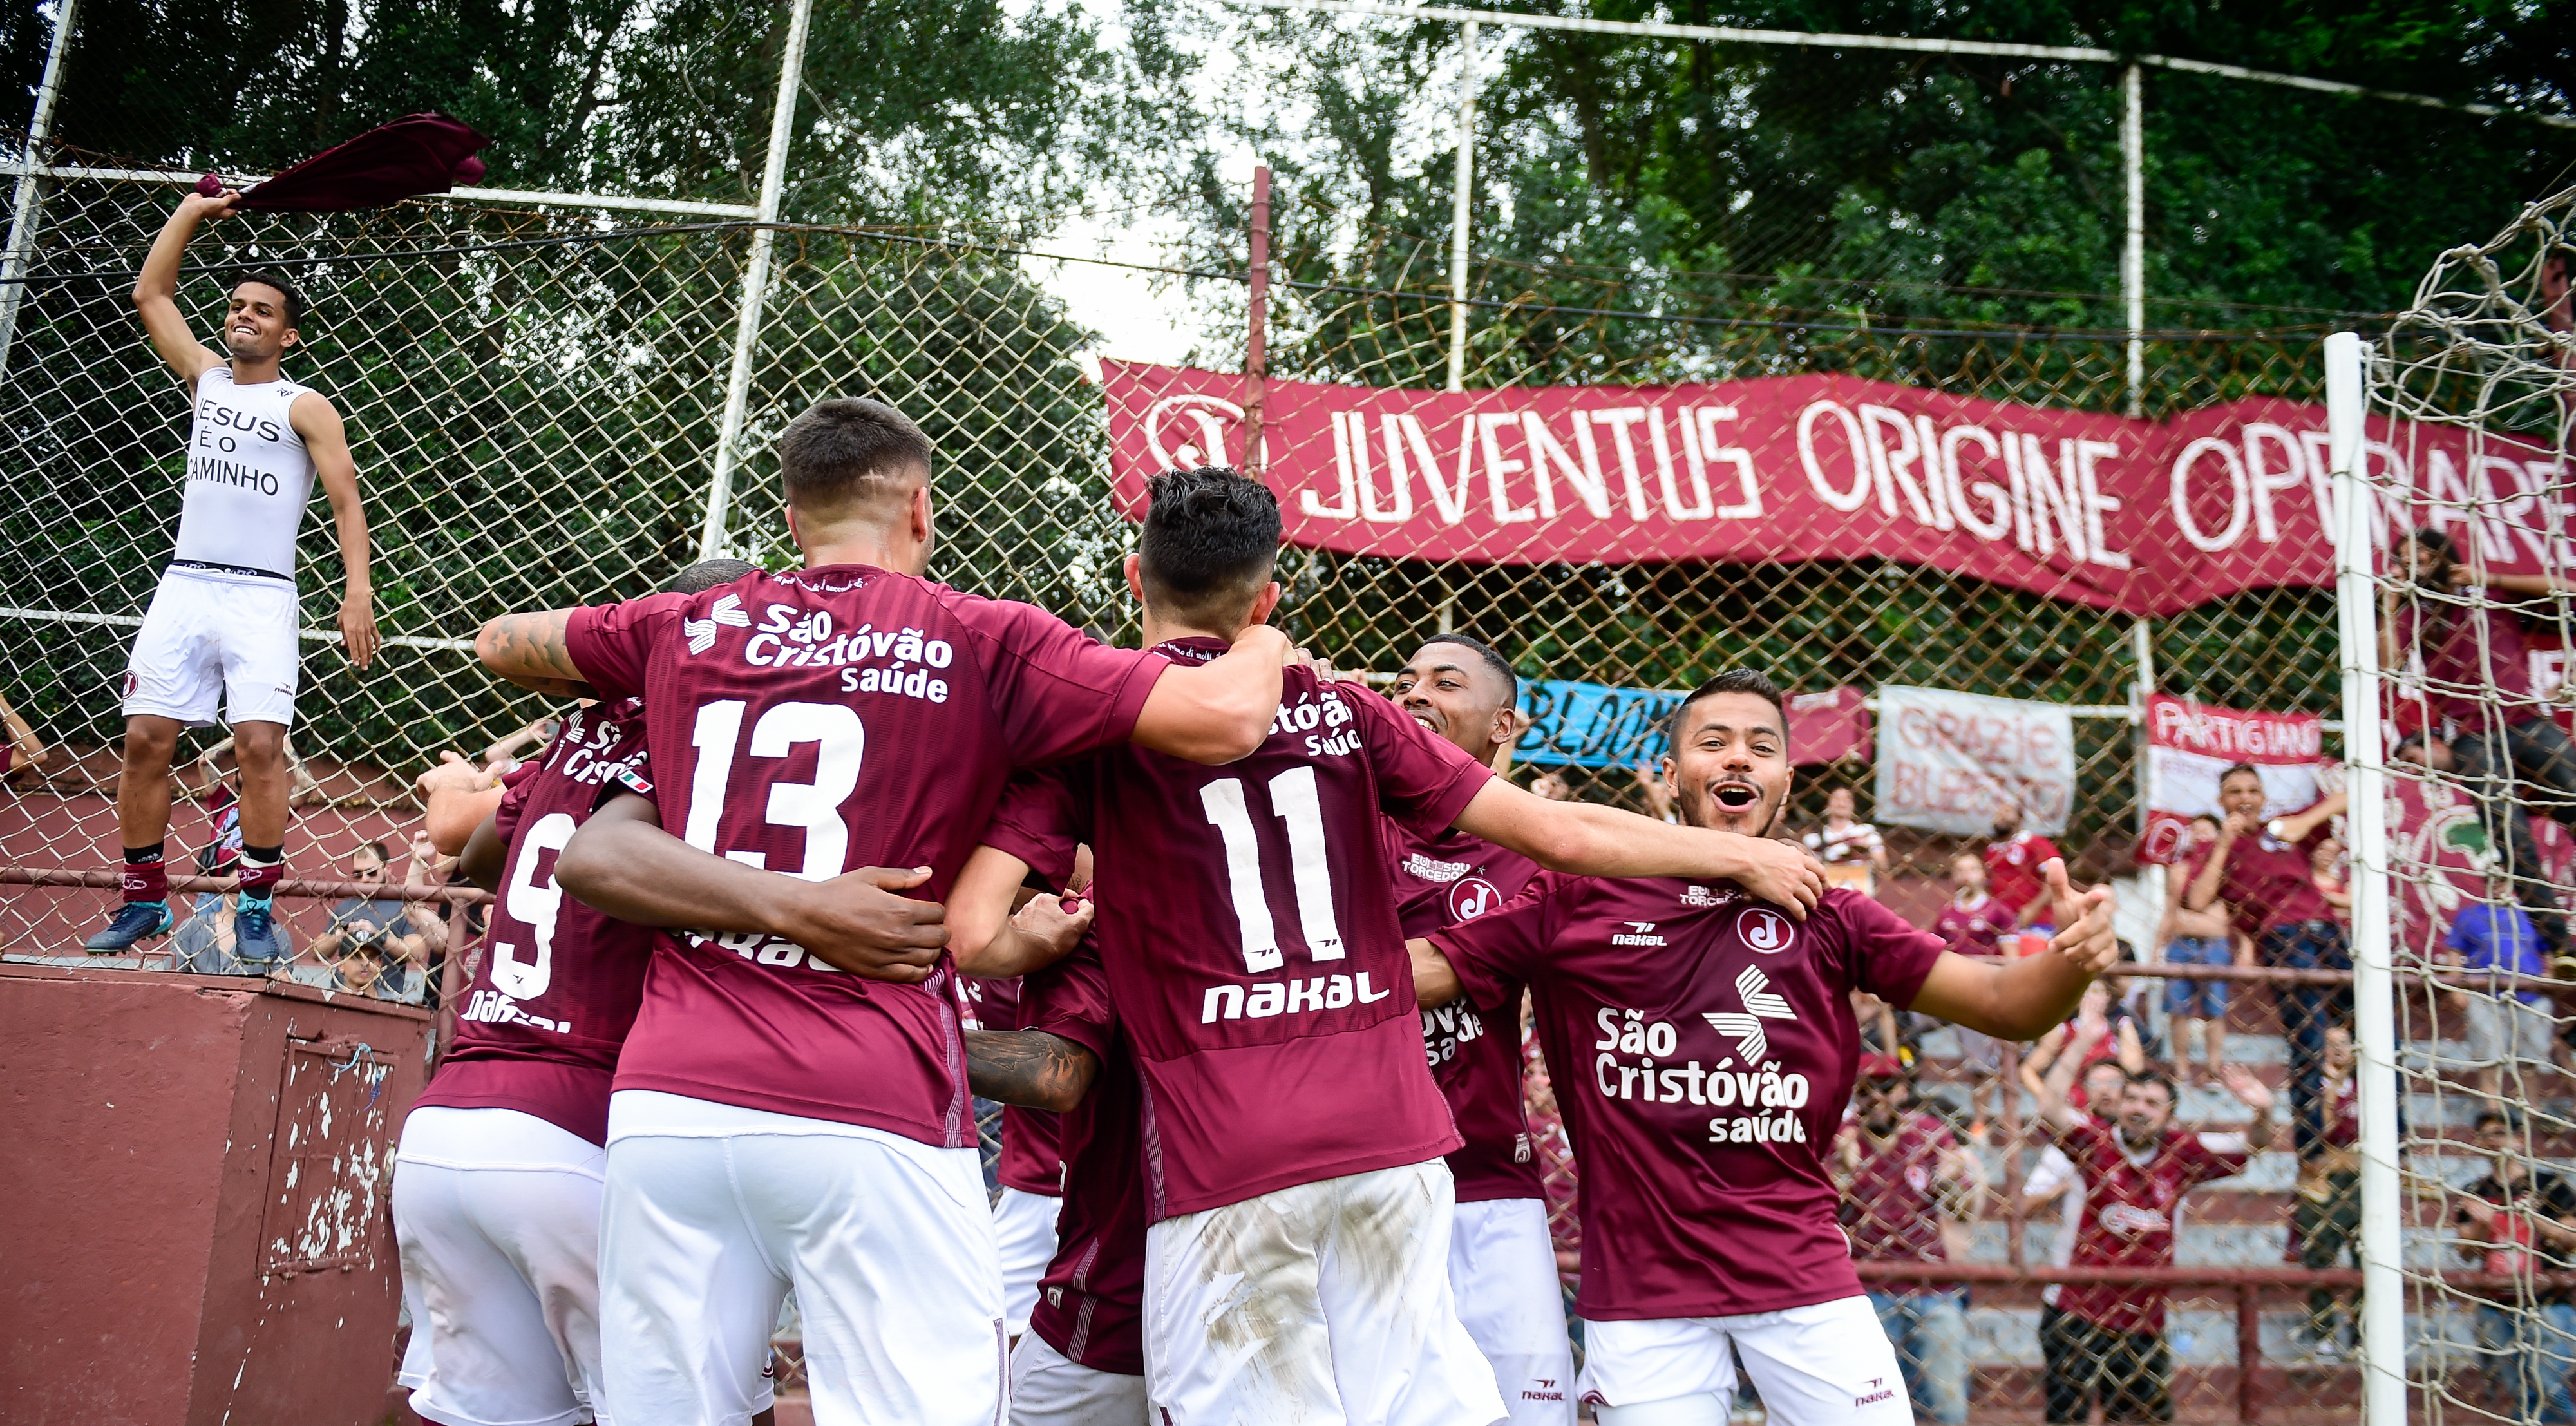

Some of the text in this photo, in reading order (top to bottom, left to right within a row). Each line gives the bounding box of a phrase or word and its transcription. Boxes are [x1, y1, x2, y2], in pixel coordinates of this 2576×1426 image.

[200, 426, 236, 453] É O
[1300, 407, 1763, 524] JUVENTUS
[1796, 399, 2132, 571] ORIGINE
[744, 623, 954, 669] Cristóvão
[840, 660, 949, 704] saúde
[684, 699, 866, 883] 13
[1198, 765, 1346, 973] 11
[490, 813, 577, 1001] 9
[1595, 1007, 1677, 1058] São
[1596, 1052, 1809, 1108] Cristóvão
[1709, 1108, 1806, 1143] saúde
